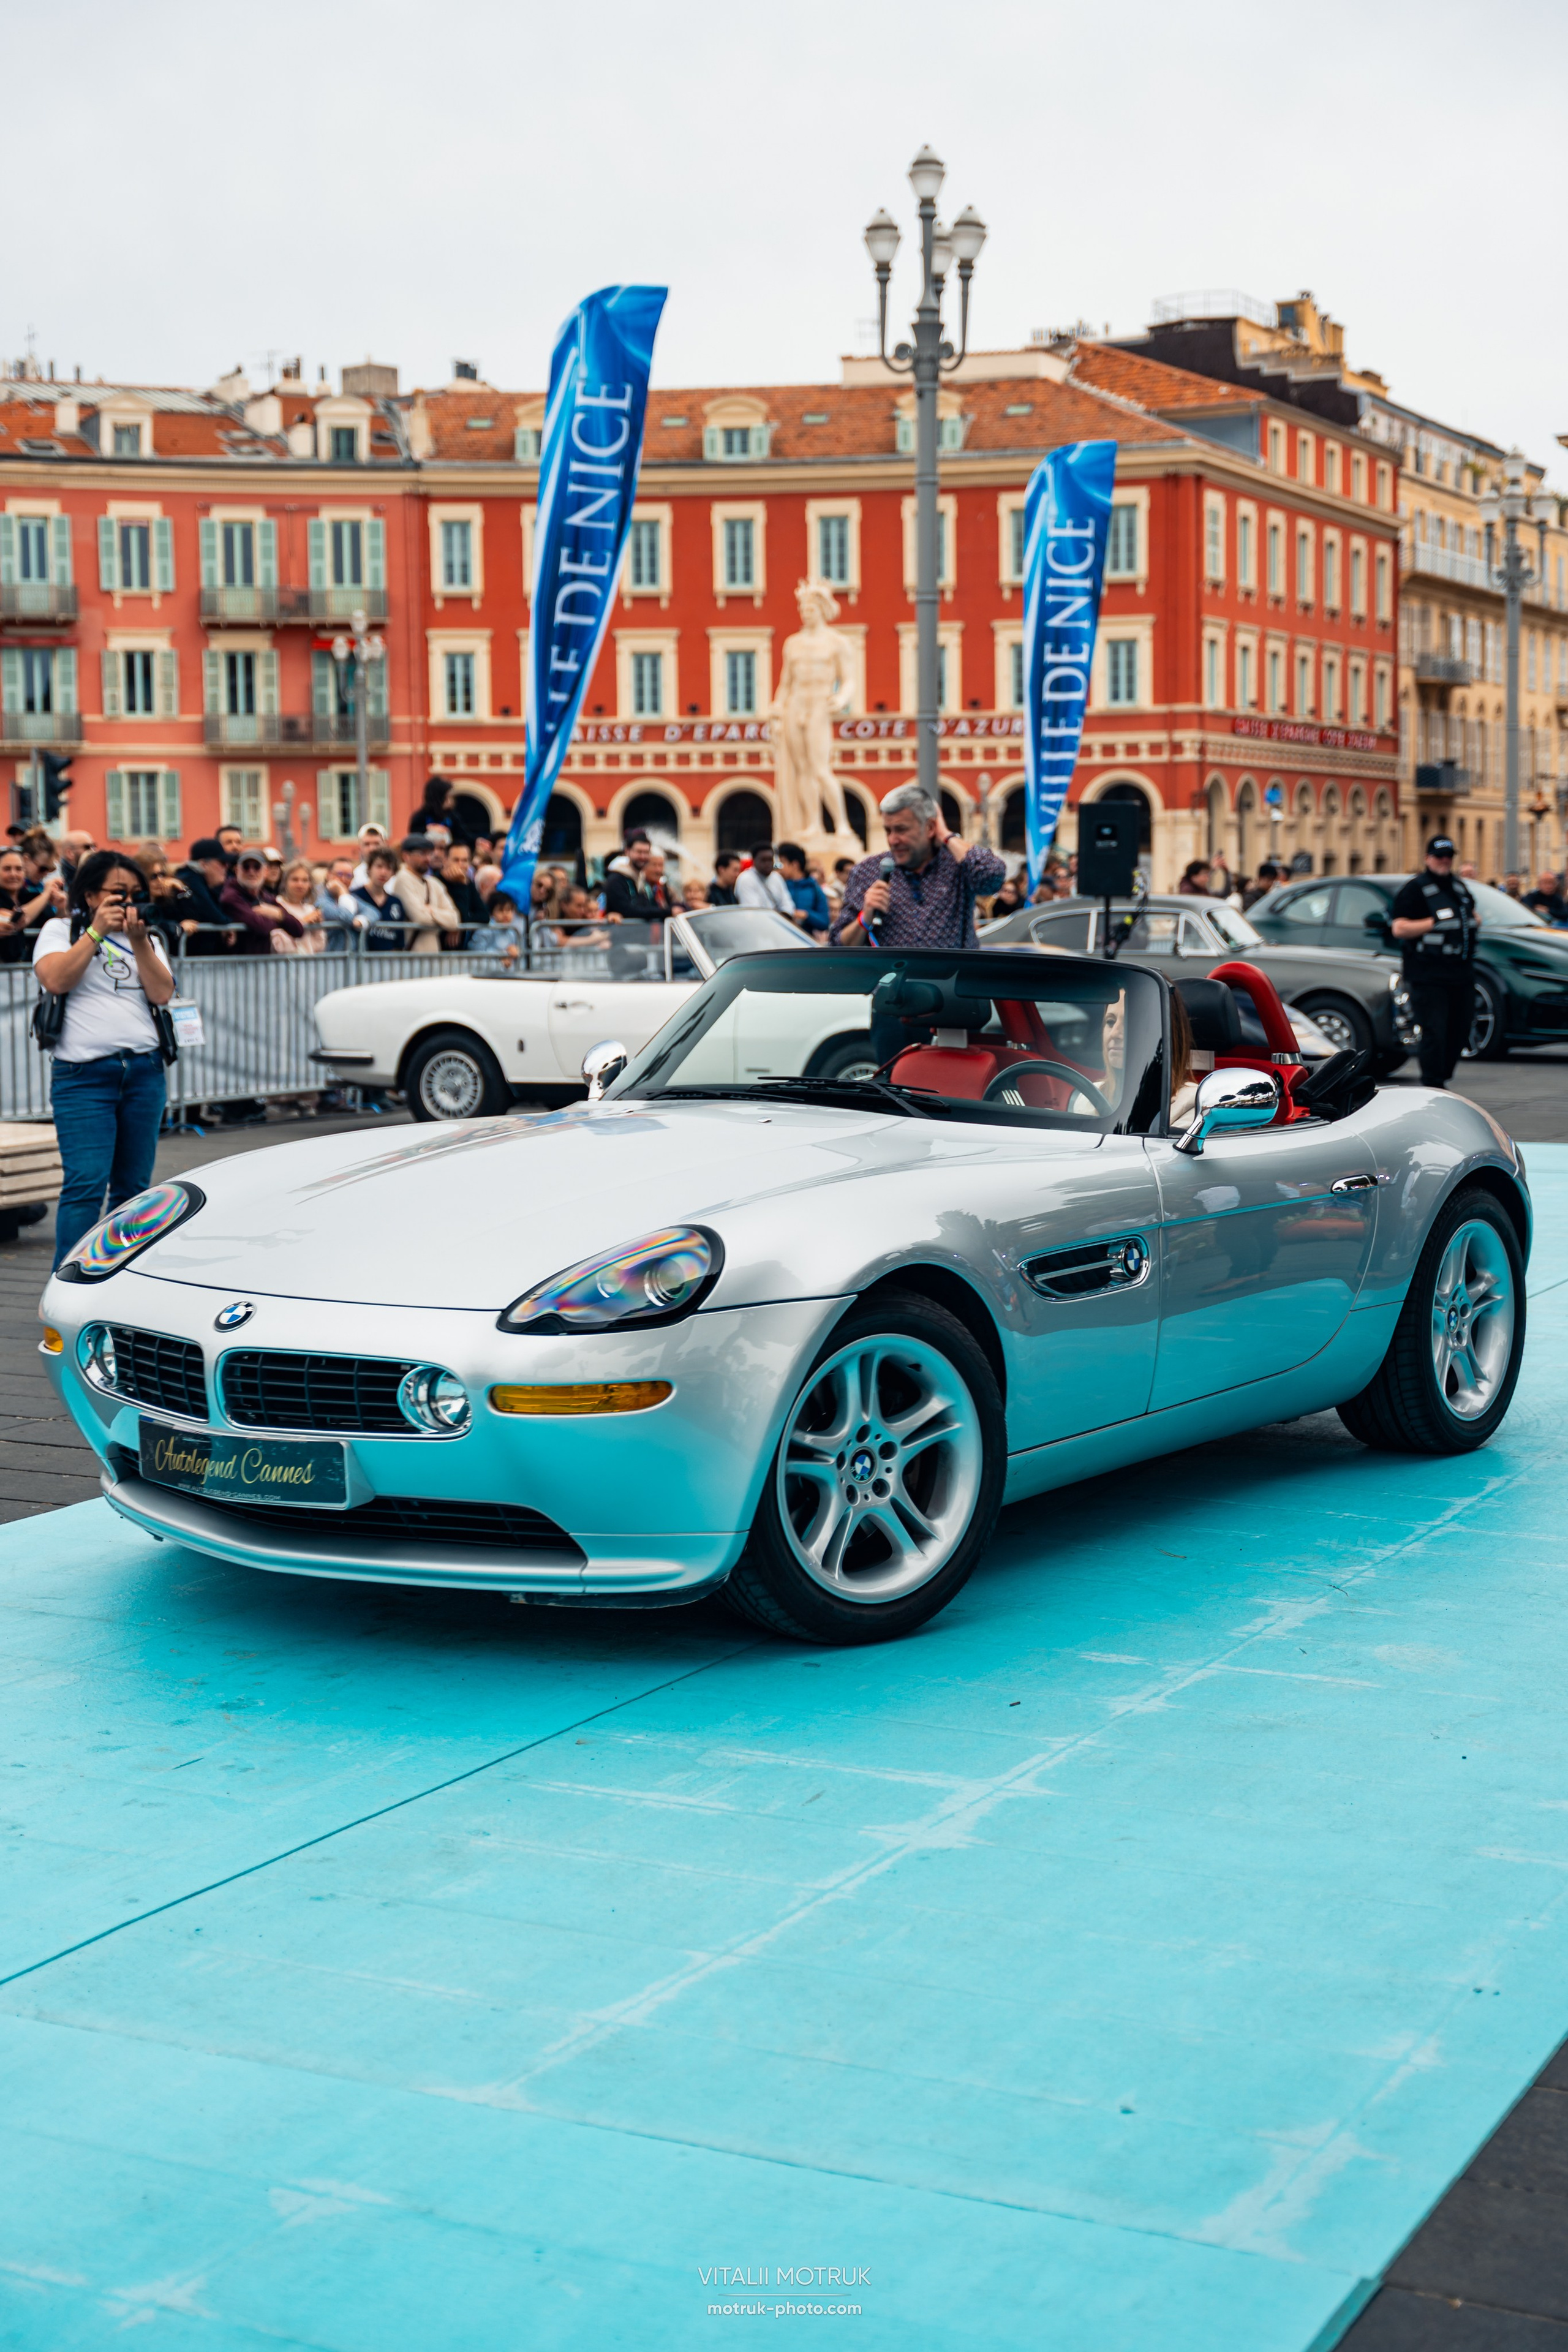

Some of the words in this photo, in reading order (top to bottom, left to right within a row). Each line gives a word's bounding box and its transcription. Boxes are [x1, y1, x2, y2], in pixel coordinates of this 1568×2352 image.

[564, 380, 633, 531] NICE
[554, 546, 611, 627] DE
[1044, 515, 1095, 629] NICE
[1042, 642, 1090, 704] DE
[571, 724, 643, 744] AISSE
[154, 1436, 238, 1485] Autolegend
[241, 1448, 315, 1484] Cannes
